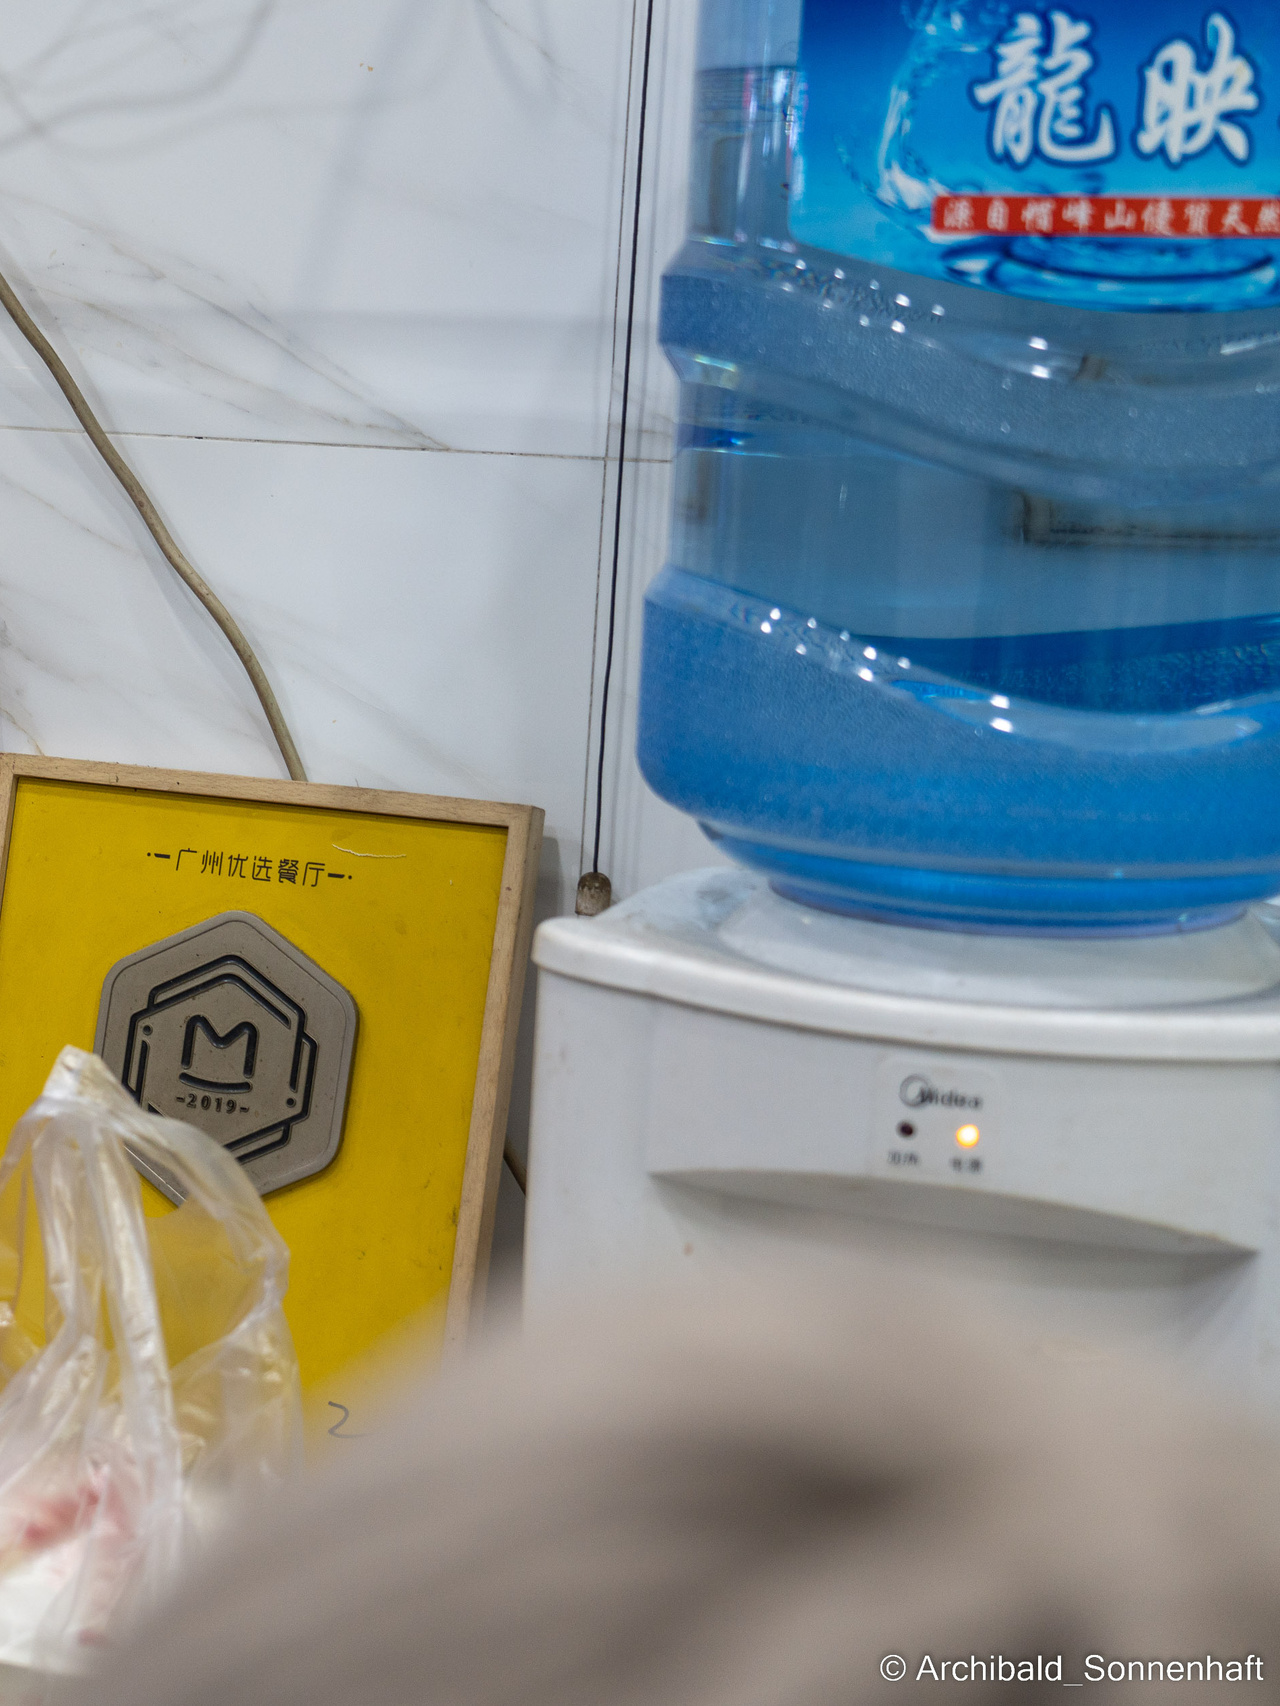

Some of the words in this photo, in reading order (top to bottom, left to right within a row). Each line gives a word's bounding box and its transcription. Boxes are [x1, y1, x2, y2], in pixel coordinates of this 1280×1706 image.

[974, 11, 1260, 163] 龍映
[176, 847, 326, 888] 广州优选餐厅
